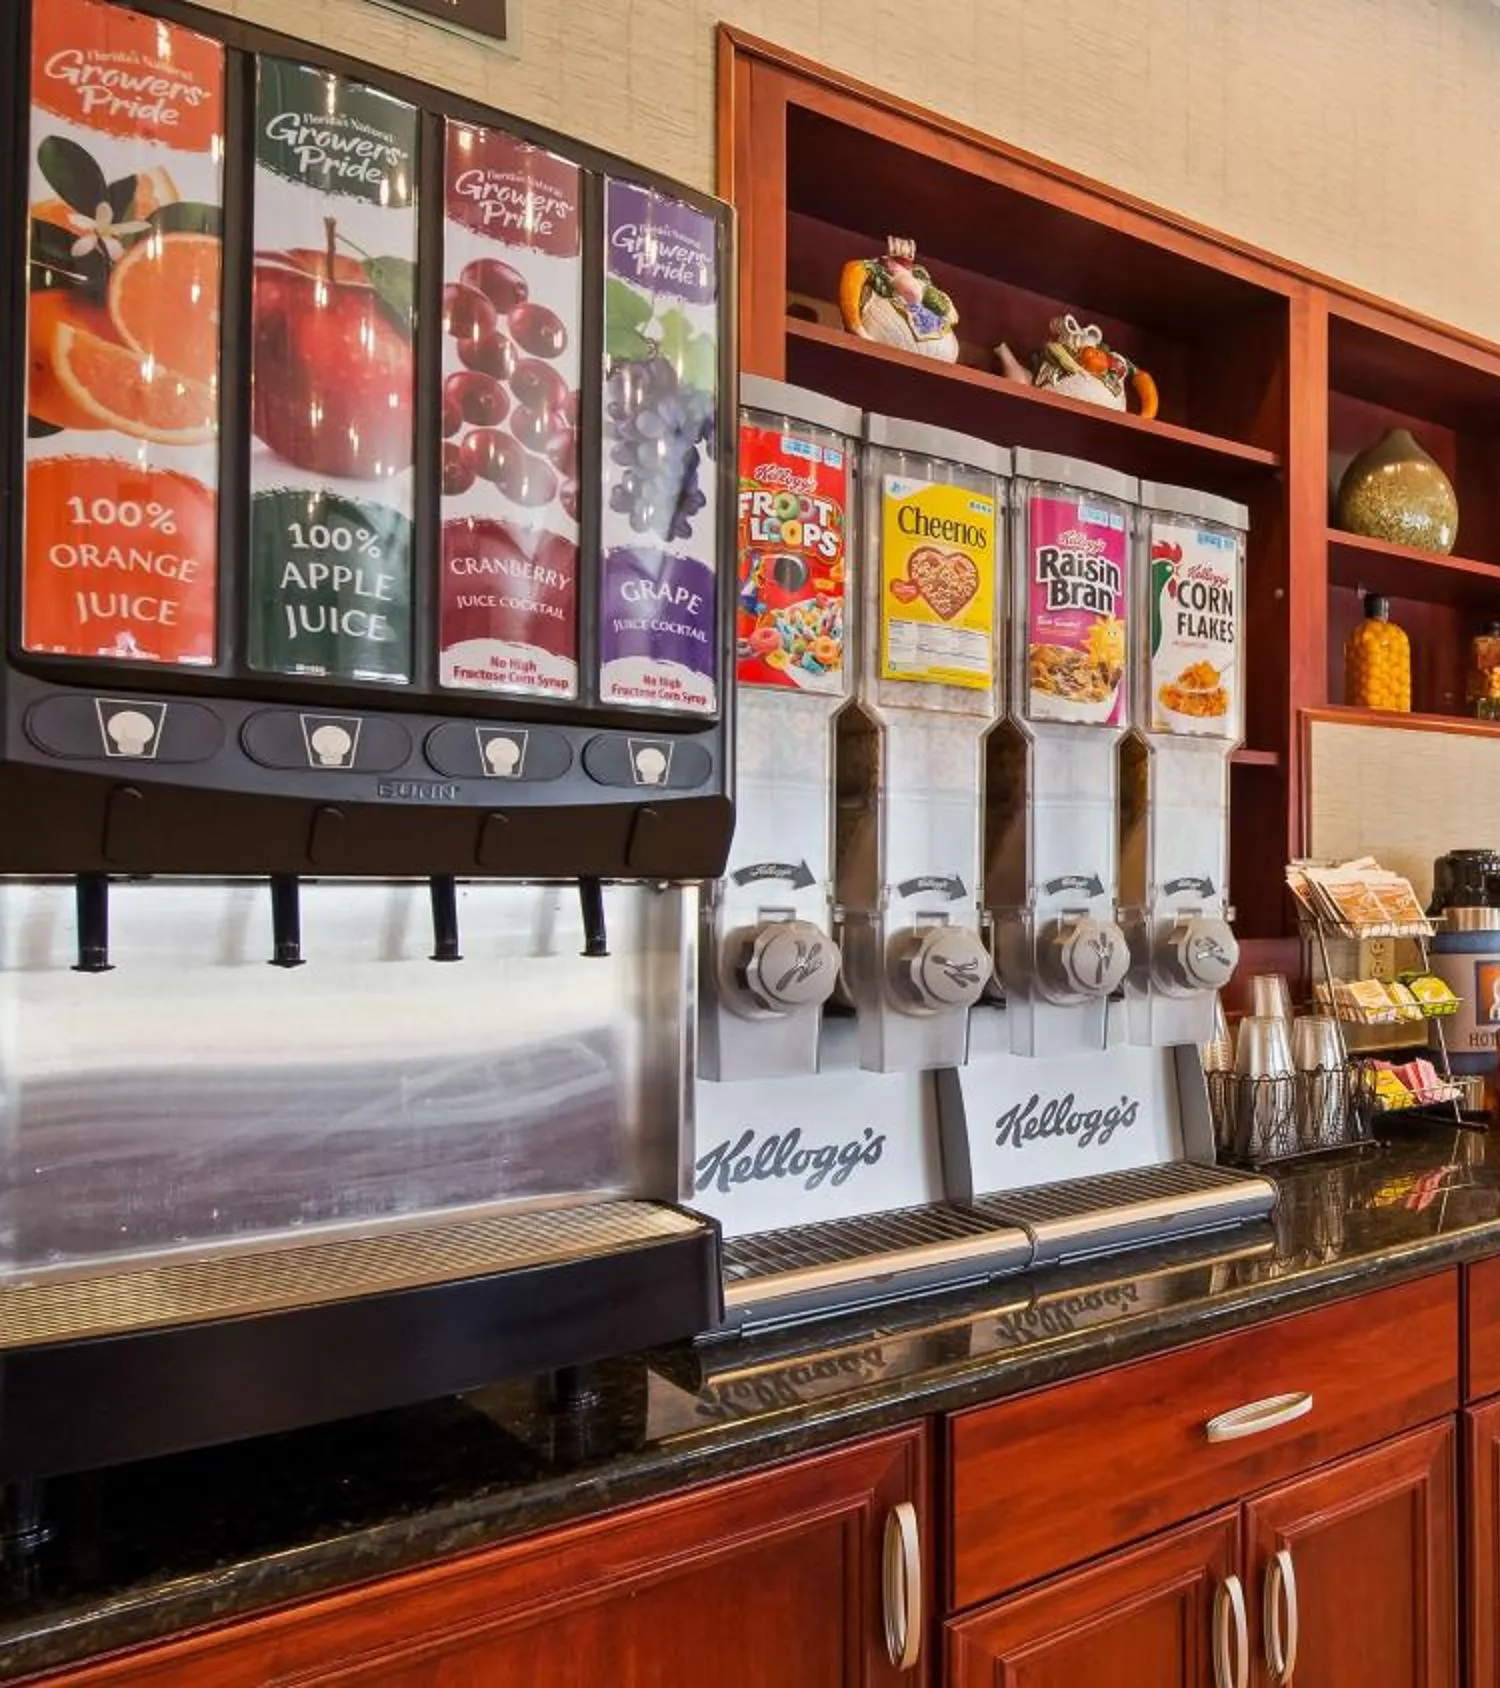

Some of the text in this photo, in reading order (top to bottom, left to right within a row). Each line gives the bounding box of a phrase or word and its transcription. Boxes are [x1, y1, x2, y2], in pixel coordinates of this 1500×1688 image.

[77, 85, 179, 126] Pride
[293, 145, 383, 184] Pride
[479, 200, 553, 235] Pride
[66, 495, 178, 535] 100%
[738, 491, 833, 527] FROOT
[897, 504, 988, 549] Cheerios
[288, 522, 382, 559] 100%
[750, 517, 840, 557] LOOPS
[49, 543, 200, 583] ORANGE
[280, 560, 396, 602] APPLE
[450, 557, 573, 591] CRANBERRY
[1037, 546, 1121, 594] Raisin
[76, 591, 180, 626] JUICE
[456, 595, 567, 621] JUICE COCKTAIL
[621, 579, 703, 616] GRAPE
[1048, 579, 1114, 615] Bran
[1177, 579, 1234, 618] CORN
[285, 604, 388, 641] JUICE
[613, 619, 709, 643] JUICE COCKTAIL
[1177, 612, 1235, 644] FLAKES
[453, 665, 570, 690] Fructose Corn Syrup
[490, 655, 538, 673] No High
[995, 1093, 1140, 1149] Kellogg's
[695, 1127, 887, 1193] Kellogg's
